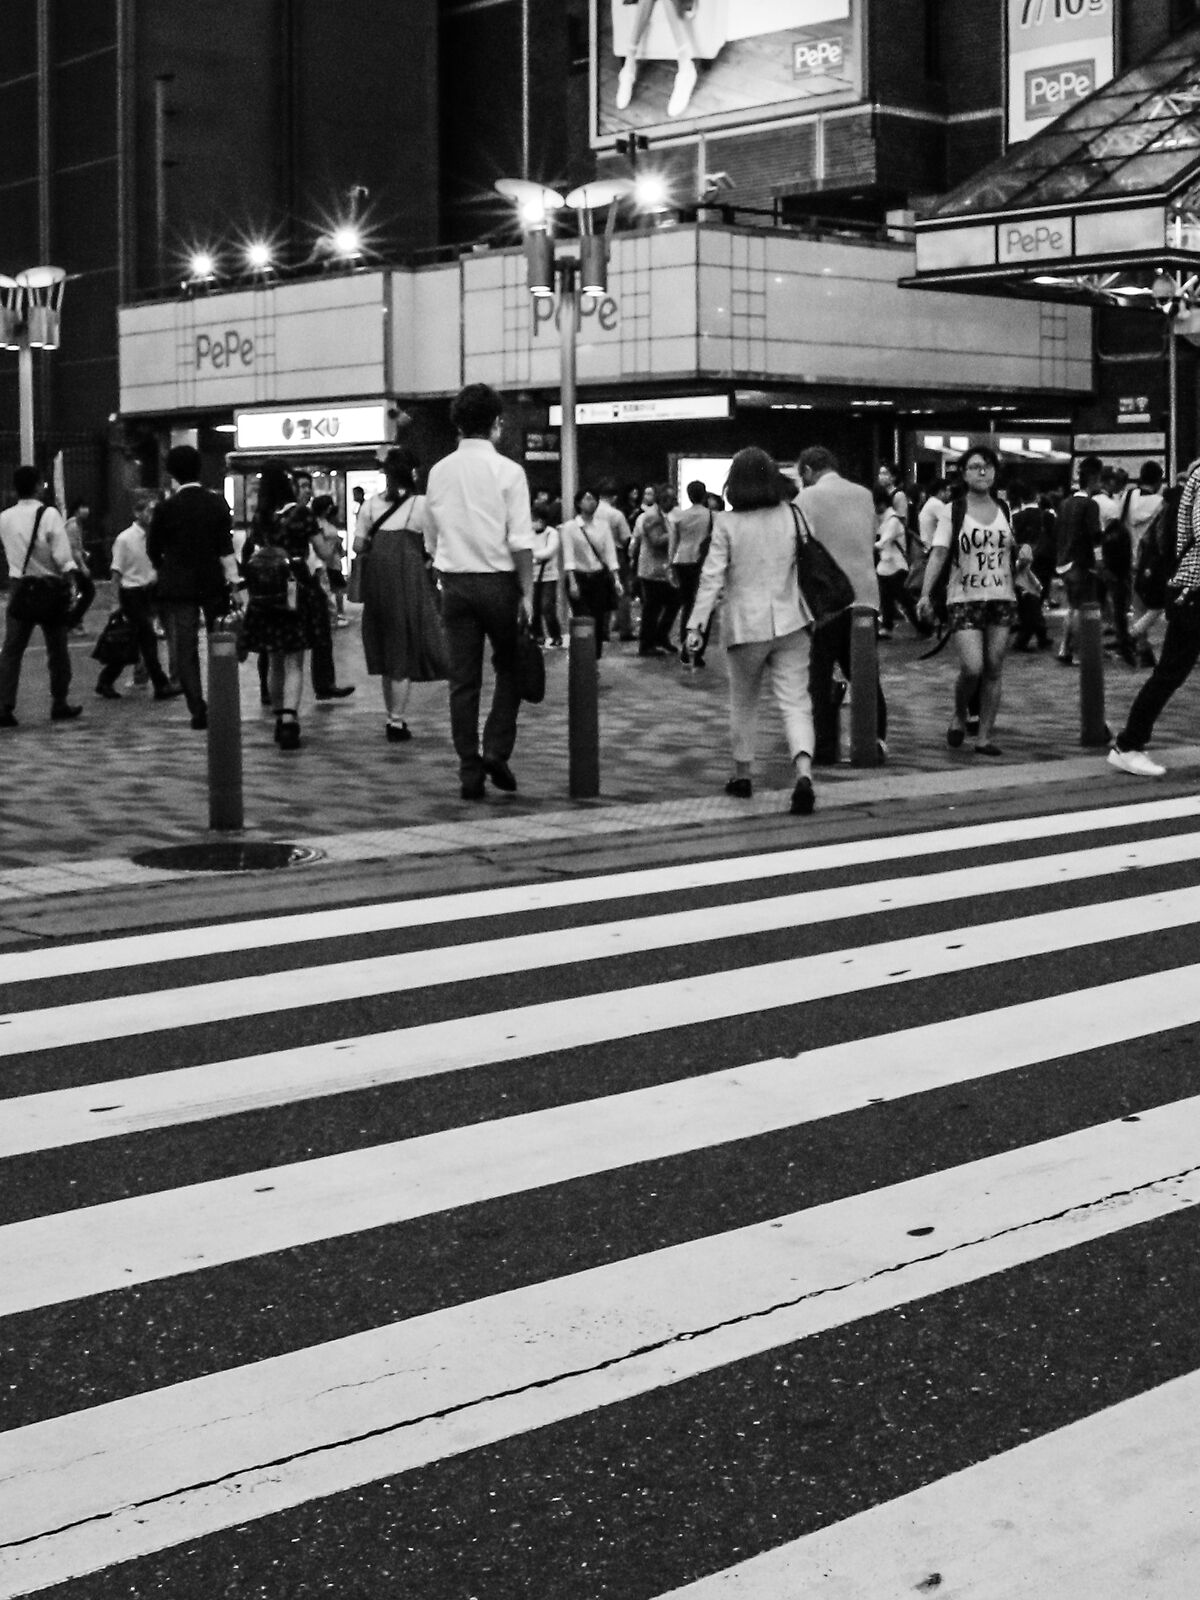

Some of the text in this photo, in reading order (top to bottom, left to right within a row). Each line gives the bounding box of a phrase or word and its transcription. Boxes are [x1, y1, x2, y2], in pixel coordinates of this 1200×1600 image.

[795, 42, 842, 68] PePe
[1030, 72, 1091, 105] PePe
[1007, 226, 1063, 254] PePe
[533, 295, 618, 337] PPe
[196, 329, 254, 370] PePe
